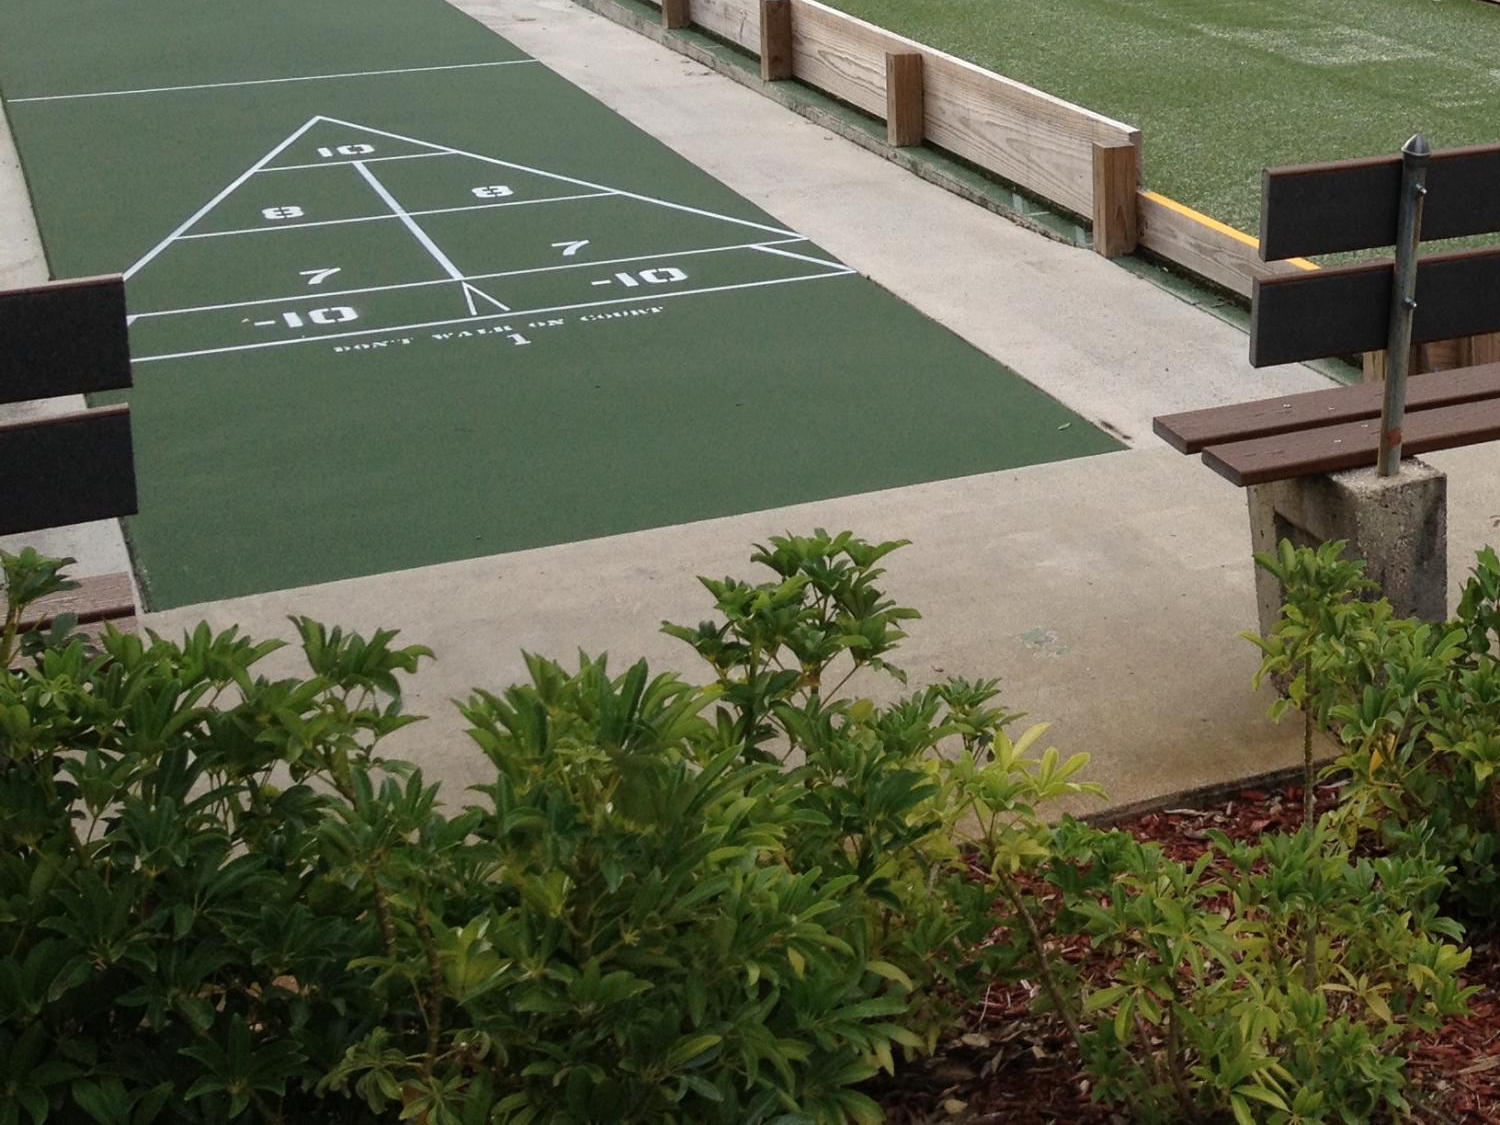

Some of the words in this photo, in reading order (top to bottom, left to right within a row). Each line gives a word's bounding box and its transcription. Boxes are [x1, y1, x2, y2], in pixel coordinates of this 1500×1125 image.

[317, 143, 375, 158] 10
[471, 185, 514, 198] 8
[262, 206, 304, 220] 8
[551, 239, 590, 256] 7
[299, 267, 341, 285] 7
[591, 267, 688, 287] -10
[253, 306, 359, 328] -10
[506, 333, 531, 346] 1
